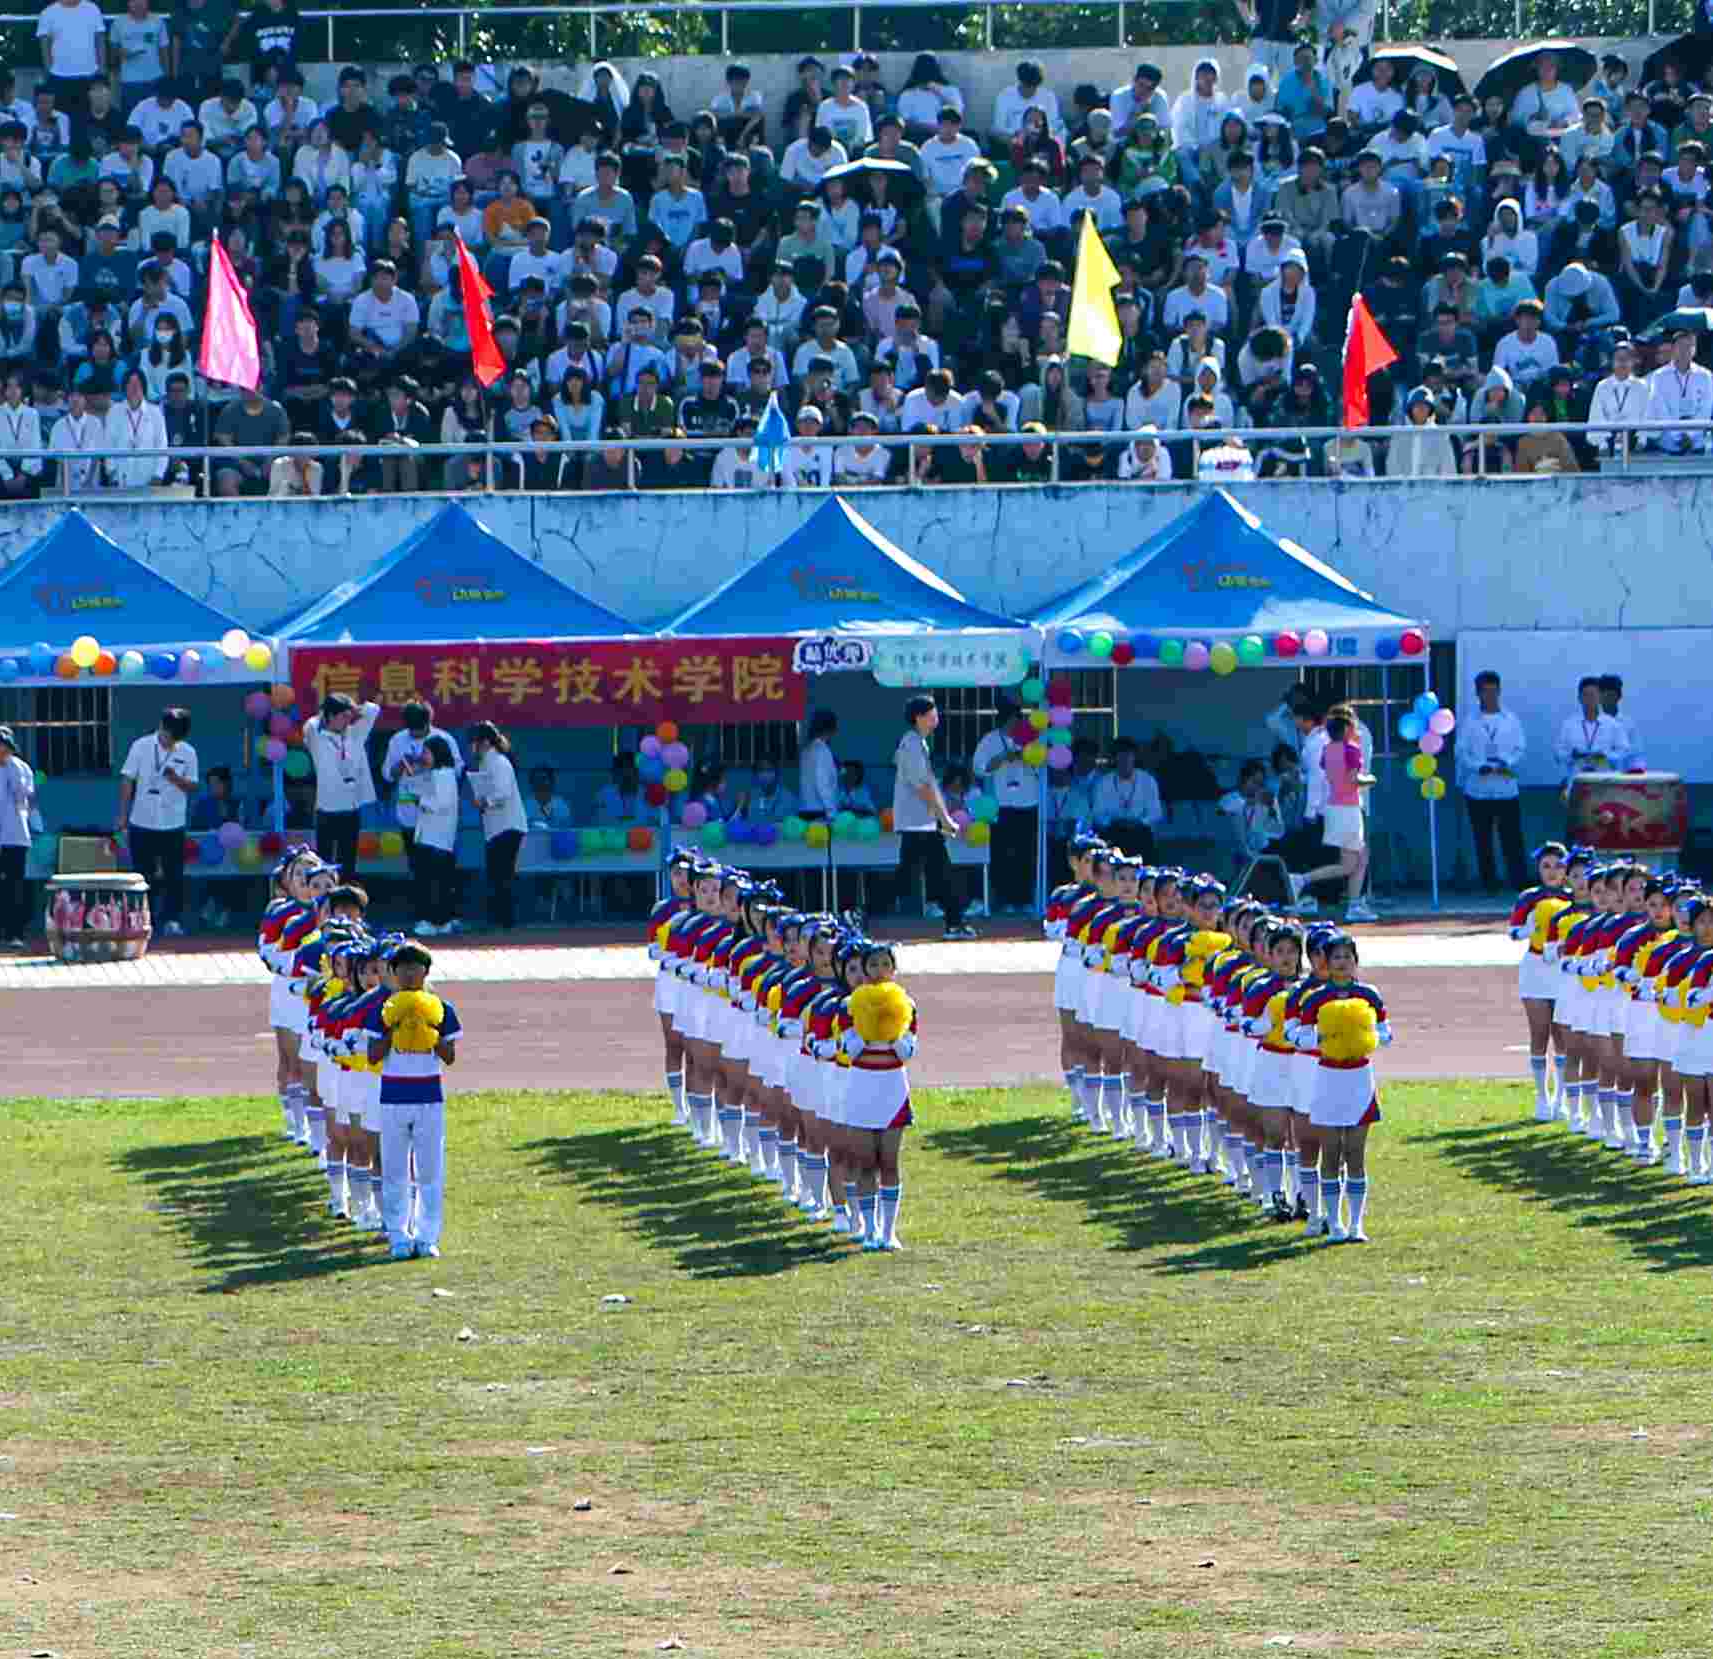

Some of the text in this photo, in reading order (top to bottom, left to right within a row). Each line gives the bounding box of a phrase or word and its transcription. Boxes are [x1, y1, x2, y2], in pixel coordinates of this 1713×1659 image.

[311, 653, 785, 704] 信息科学技术学院
